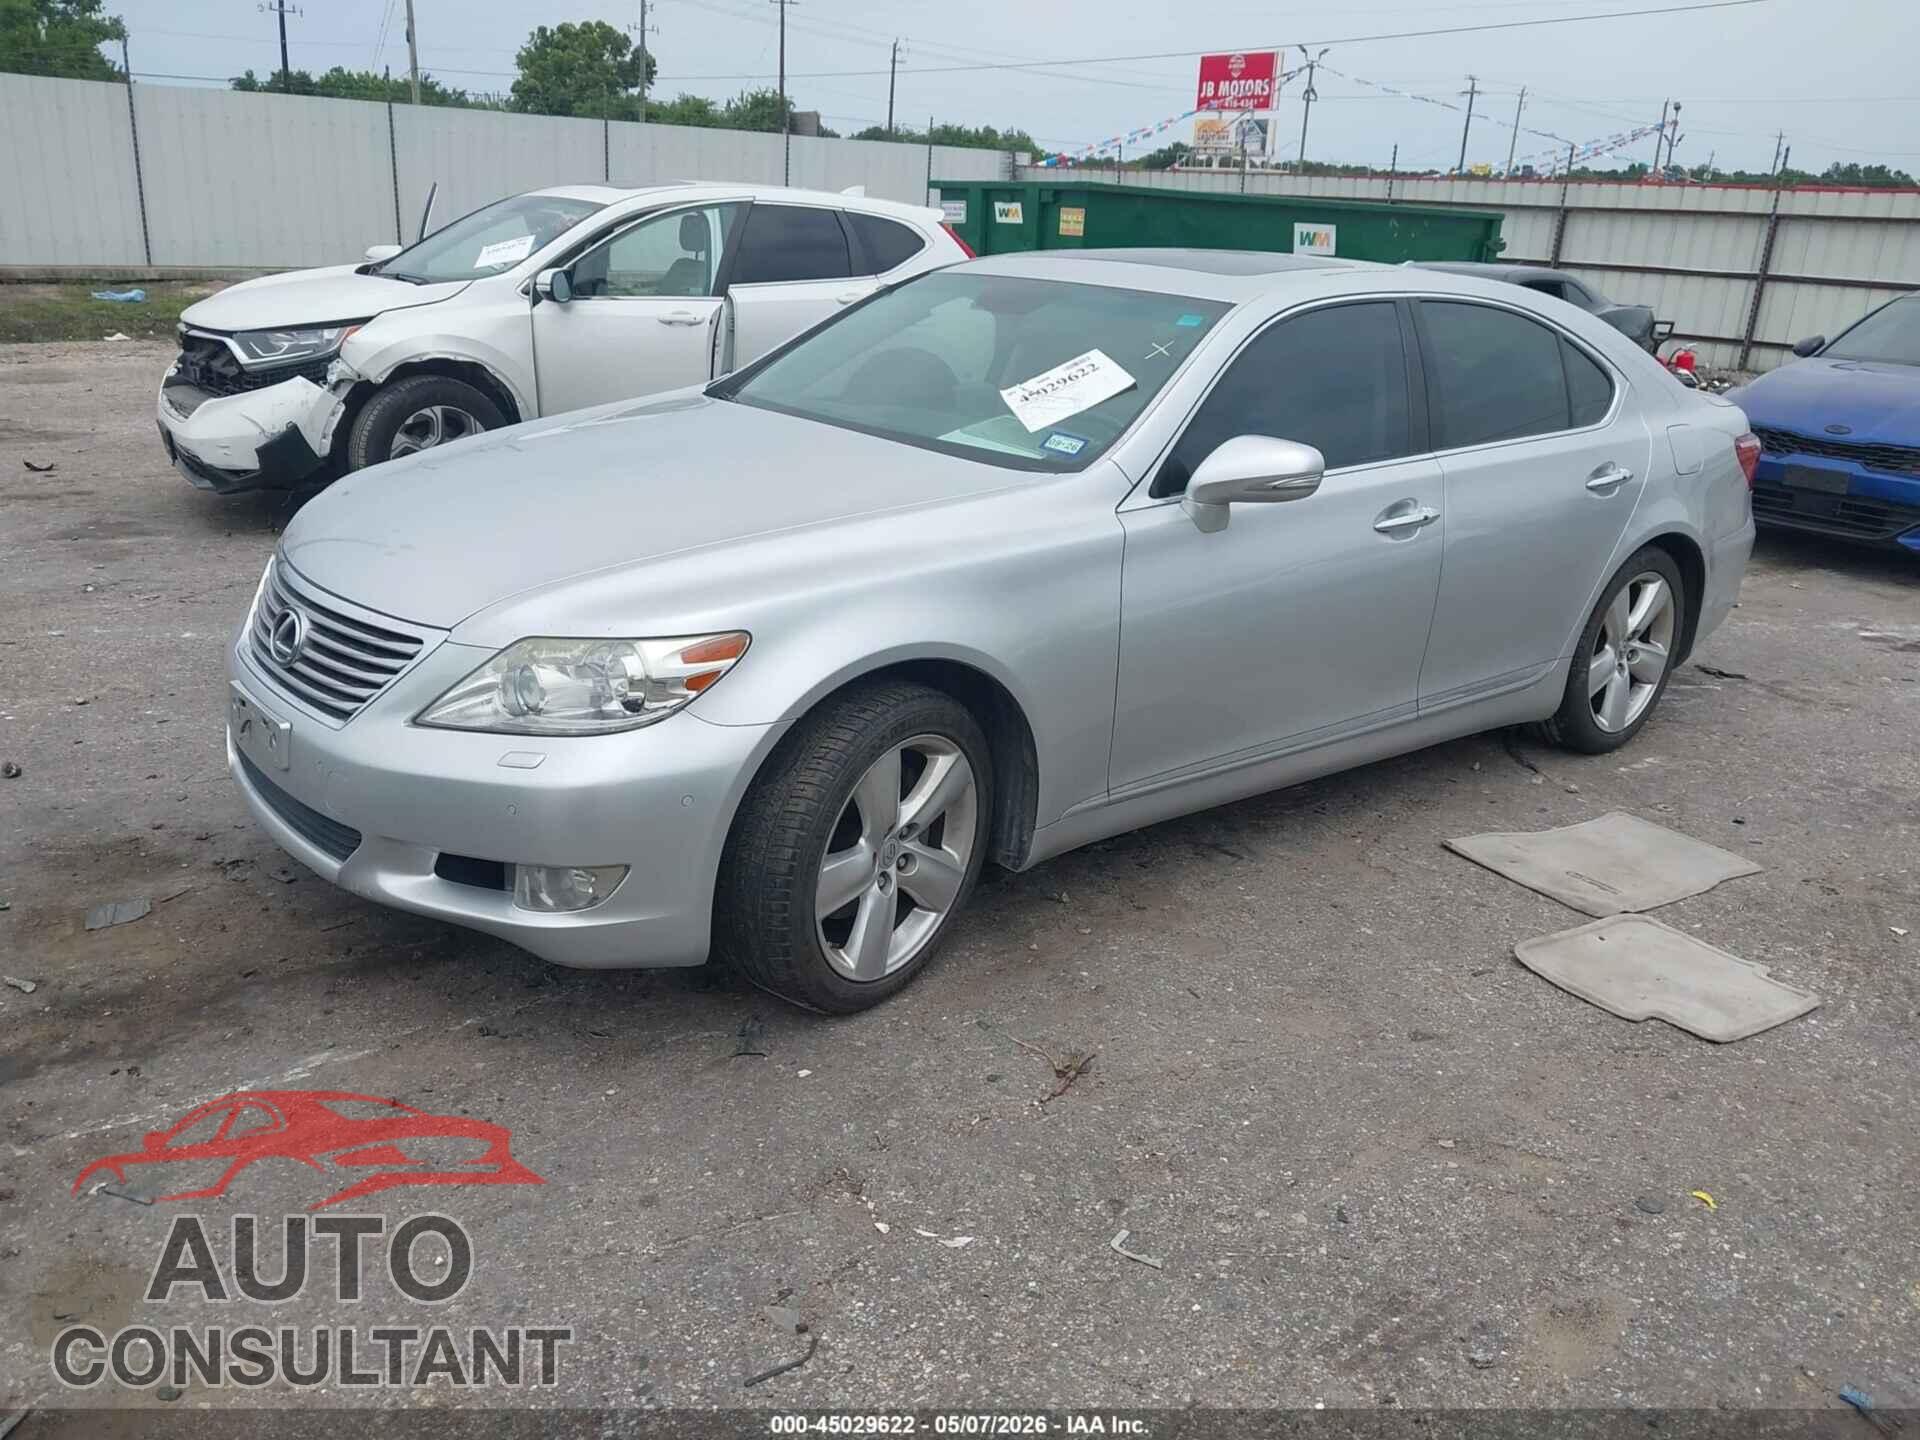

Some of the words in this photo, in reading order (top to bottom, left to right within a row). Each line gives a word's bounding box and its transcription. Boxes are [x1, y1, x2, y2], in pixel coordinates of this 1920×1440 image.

[1200, 81, 1215, 98] JB
[1219, 79, 1270, 98] MOTORS
[999, 207, 1019, 218] WM
[1300, 231, 1329, 246] WM
